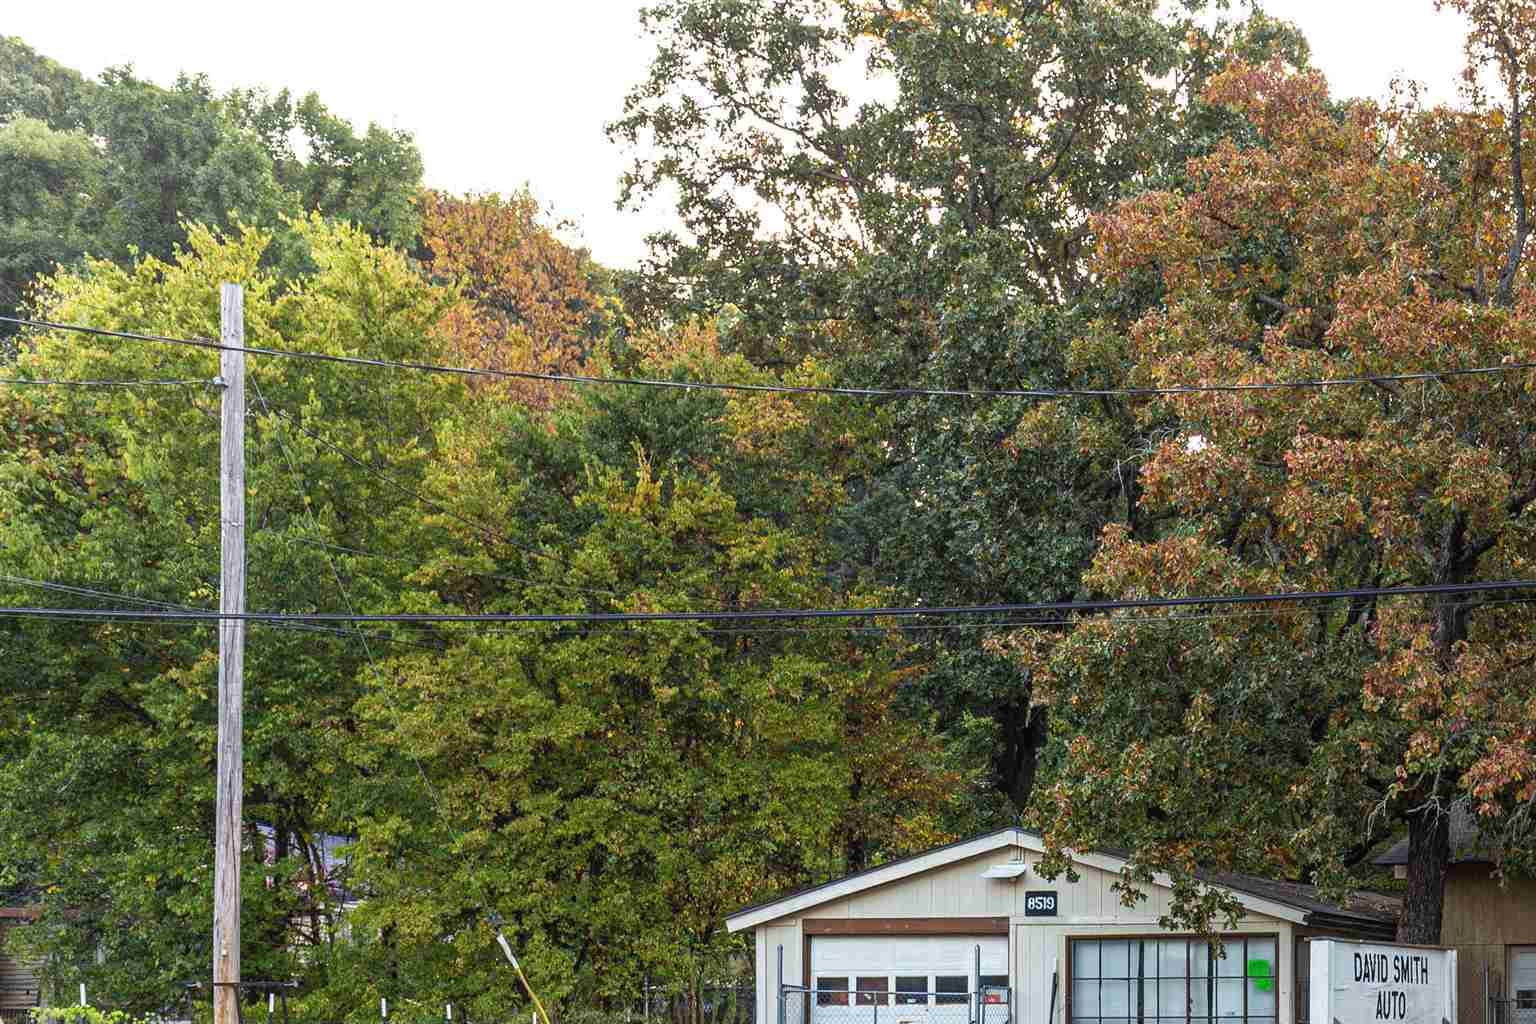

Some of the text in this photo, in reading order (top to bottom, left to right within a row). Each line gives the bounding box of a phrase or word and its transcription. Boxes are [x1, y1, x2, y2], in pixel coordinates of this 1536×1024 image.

[1028, 897, 1055, 910] 8519
[1354, 952, 1428, 984] DAVID SMITH
[1376, 991, 1406, 1020] AUTO
